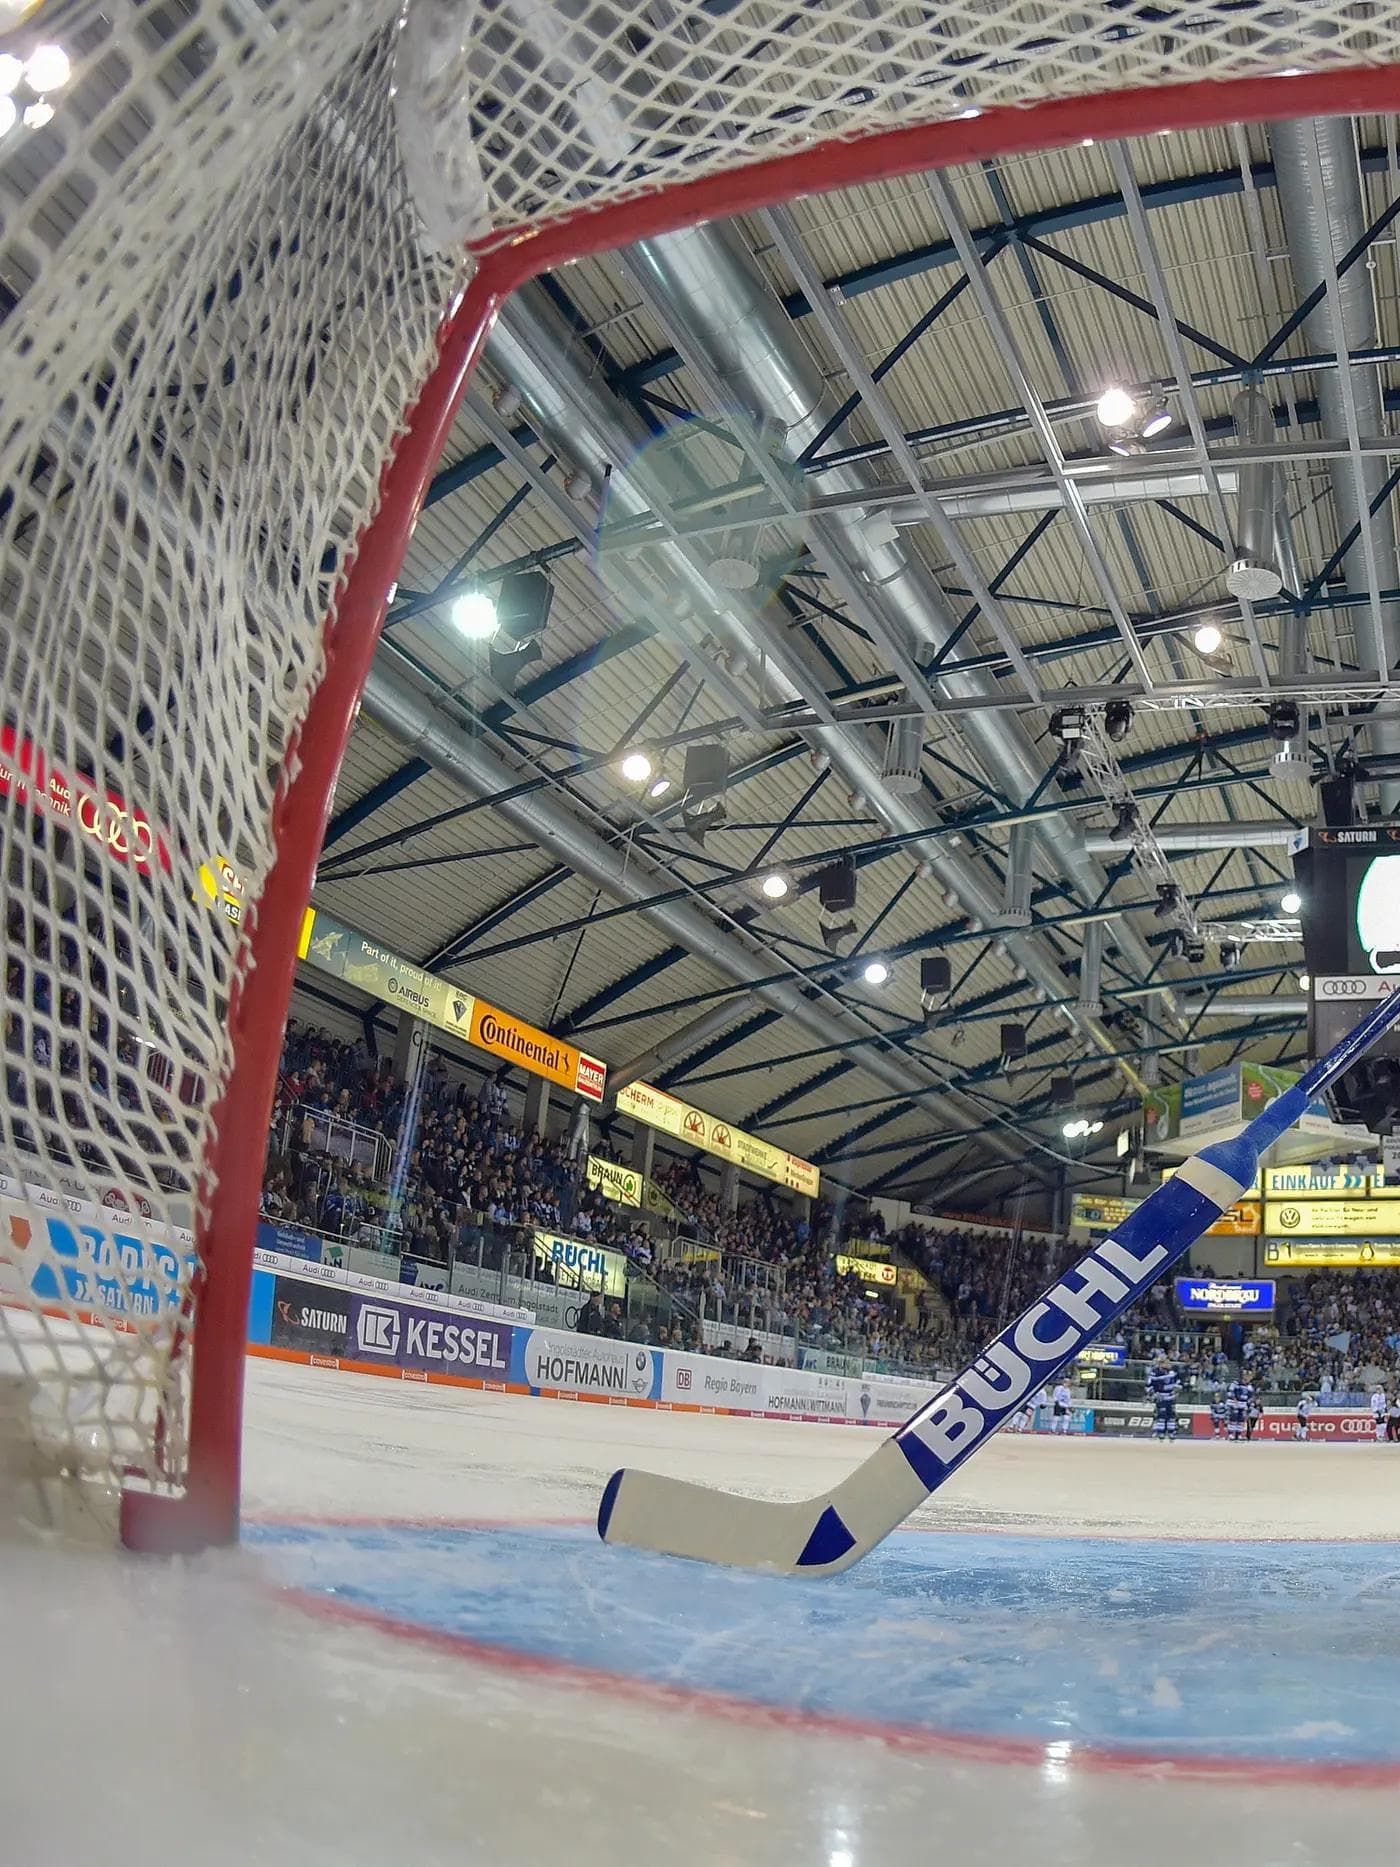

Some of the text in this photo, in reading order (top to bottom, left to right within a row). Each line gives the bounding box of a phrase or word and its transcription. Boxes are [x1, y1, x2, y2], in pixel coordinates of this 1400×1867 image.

[1337, 830, 1377, 843] SATURN
[361, 941, 379, 959] Part
[380, 953, 390, 963] of
[400, 964, 423, 982] proud
[424, 976, 433, 986] of
[399, 986, 430, 1008] AIRBUS
[479, 1014, 560, 1072] Continental
[580, 1063, 604, 1083] MAYER
[592, 1164, 623, 1186] BRAUN
[1272, 1173, 1337, 1191] EINKAUF
[552, 1240, 609, 1276] BÜCHL
[303, 1264, 320, 1275] Audi
[358, 1277, 374, 1288] Audi
[458, 1285, 479, 1297] Audi
[410, 1289, 426, 1299] Audi
[457, 1299, 472, 1309] Audi
[301, 1307, 347, 1334] SATURN
[502, 1309, 516, 1318] Audi
[406, 1316, 506, 1369] KESSEL
[911, 1239, 1169, 1465] BÜCHL
[536, 1355, 624, 1389] HOFMANN
[678, 1372, 690, 1387] DB
[704, 1375, 728, 1395] Regio
[730, 1378, 757, 1398] Bayern
[768, 1394, 805, 1411] HOFMANN
[810, 1397, 845, 1414] WITTMANN
[1269, 1420, 1336, 1434] quatro
